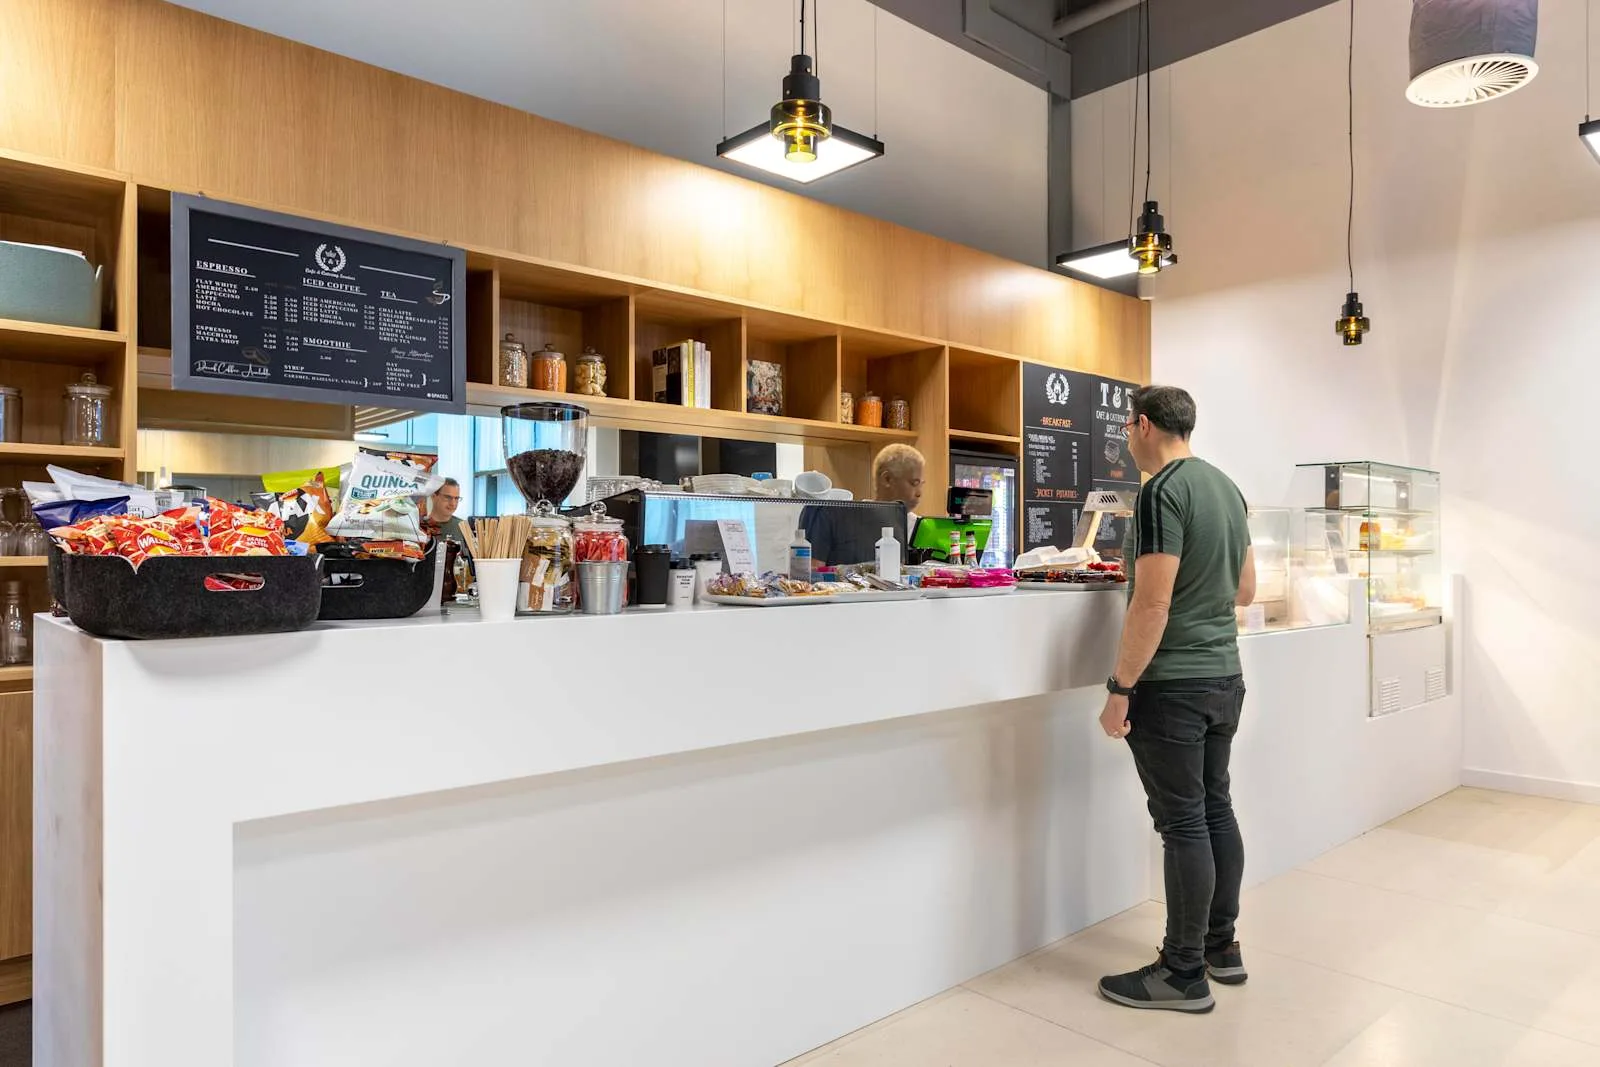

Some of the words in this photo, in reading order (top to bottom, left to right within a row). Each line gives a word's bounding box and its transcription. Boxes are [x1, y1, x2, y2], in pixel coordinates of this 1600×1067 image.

[195, 260, 249, 275] ESPRESSO
[195, 278, 213, 286] FLAT
[214, 281, 238, 289] WHITE
[303, 277, 325, 286] ICED
[327, 281, 361, 292] COFFEE
[195, 284, 238, 294] AMERICANO
[195, 289, 241, 300] CAPPUCCINO
[195, 294, 218, 302] LATTE
[380, 290, 397, 299] TEA
[195, 299, 222, 308] MOCHA
[320, 298, 356, 307] AMERICANO
[212, 307, 255, 318] CHOCOLATE
[320, 303, 359, 313] CAPPUCCINO
[320, 318, 357, 327] CHOCOLATE
[195, 325, 232, 334] ESPRESSO
[195, 330, 239, 340] MACCHIATO
[195, 335, 219, 343] EXTRA
[303, 336, 351, 349] SMOOTHIE
[1100, 382, 1109, 407] T
[1112, 386, 1122, 409] &
